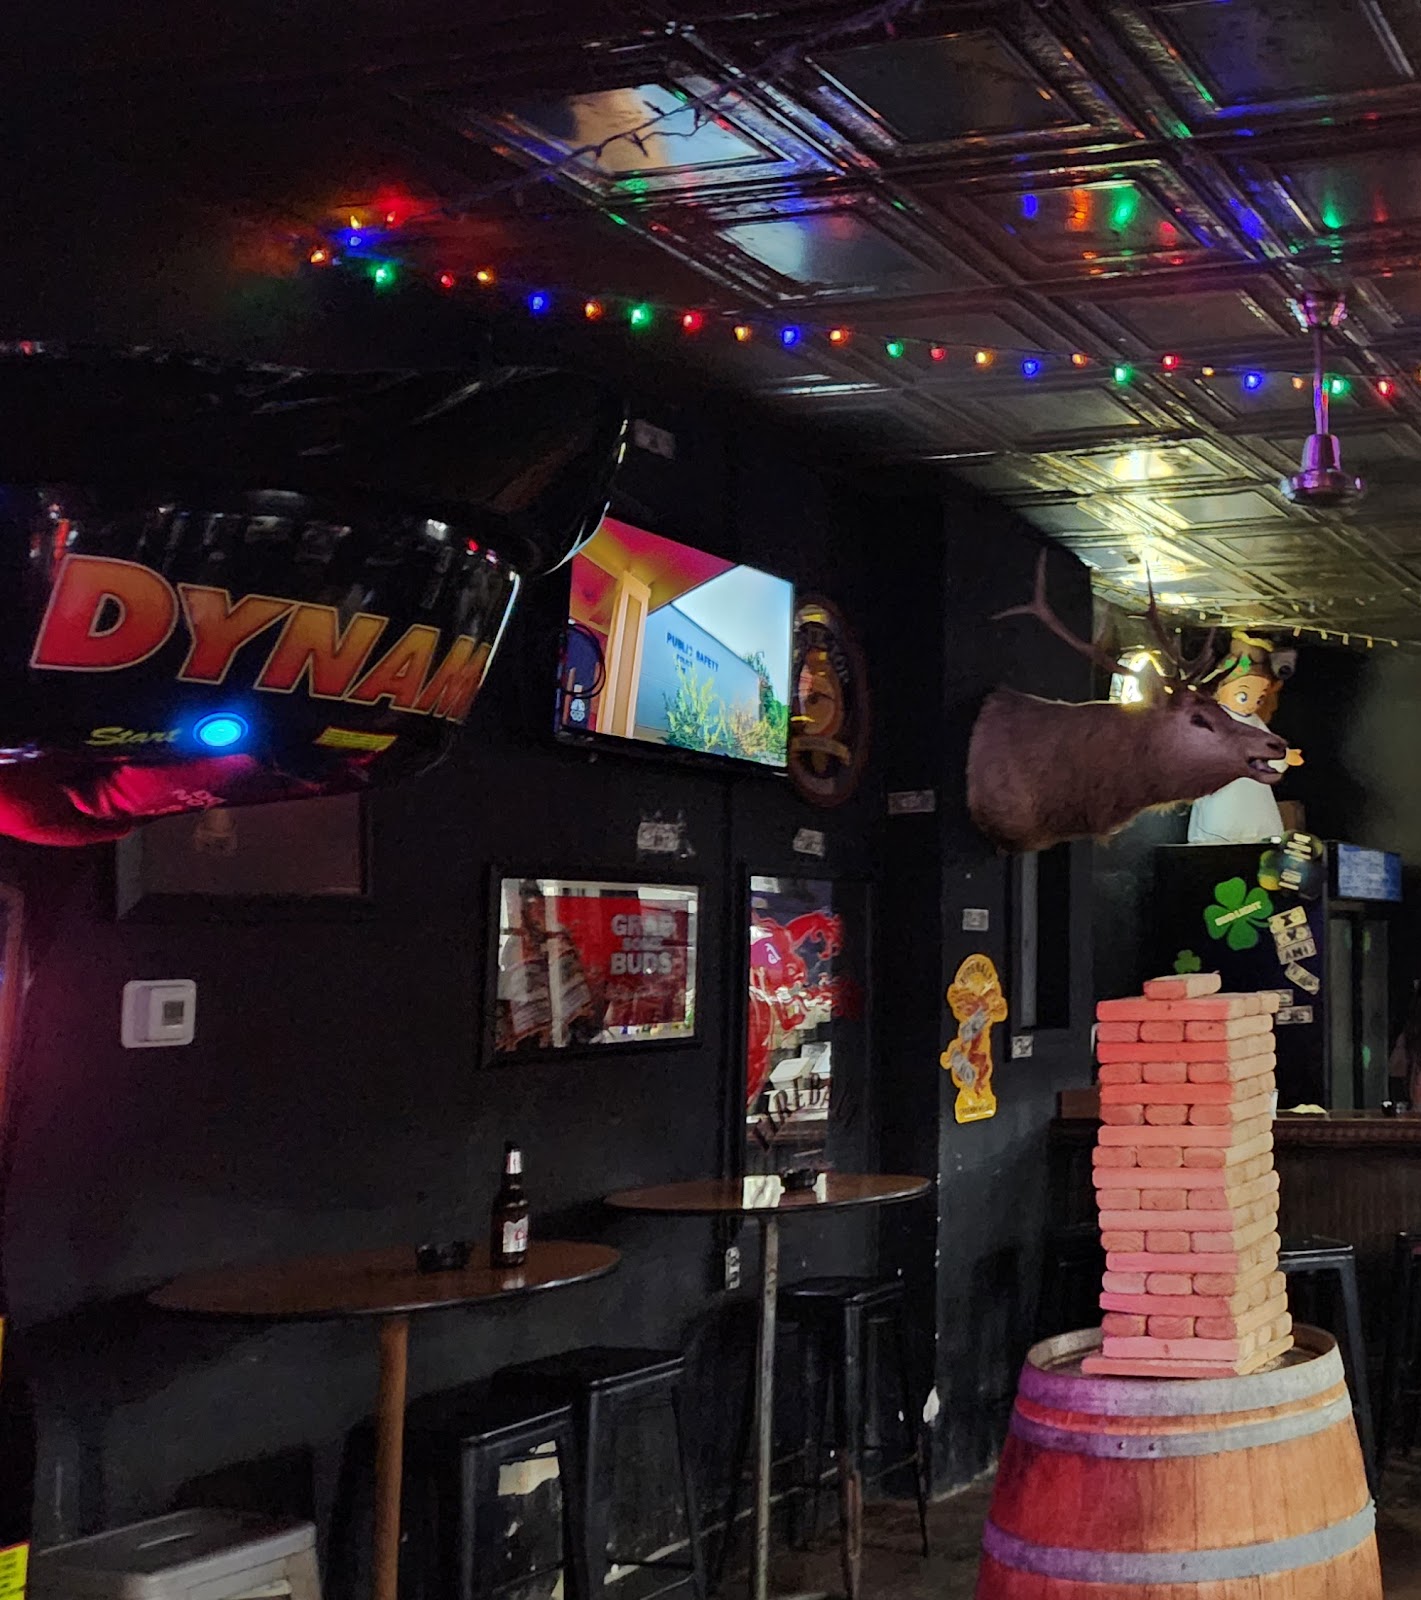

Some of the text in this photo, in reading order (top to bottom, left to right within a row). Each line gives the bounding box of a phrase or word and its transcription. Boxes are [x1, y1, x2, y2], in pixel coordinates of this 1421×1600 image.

[666, 632, 693, 657] PUBLIC
[696, 650, 719, 672] SAFETY
[83, 725, 182, 747] Start
[611, 914, 677, 937] GRAB
[610, 953, 672, 975] BUDS
